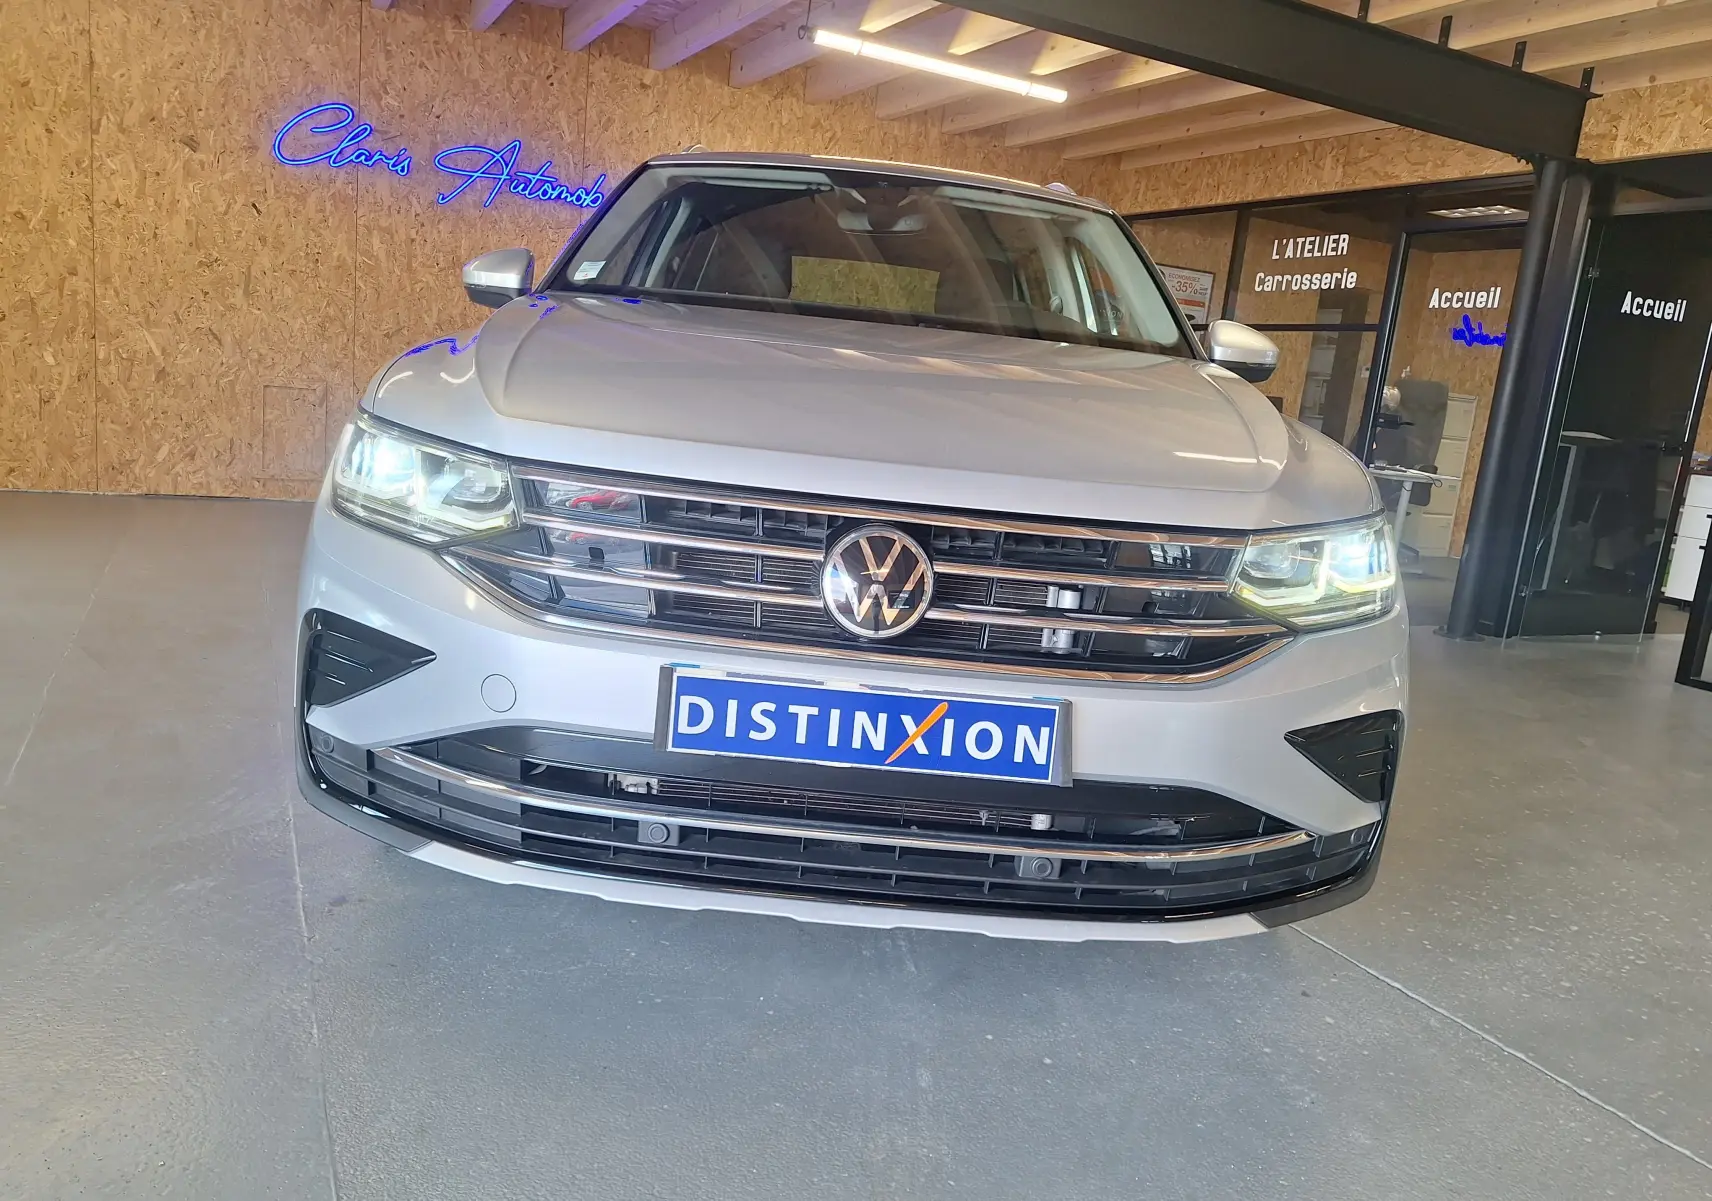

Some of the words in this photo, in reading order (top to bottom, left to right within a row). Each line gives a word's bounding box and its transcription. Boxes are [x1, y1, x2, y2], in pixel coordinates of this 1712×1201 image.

[273, 102, 412, 176] Claris
[1271, 233, 1349, 260] L'ATELIER
[1171, 280, 1198, 295] -35%
[1254, 267, 1358, 292] Carrosserie
[1428, 286, 1501, 309] Accueil
[1620, 291, 1687, 322] Accueil
[677, 695, 1050, 765] DISTINXION
